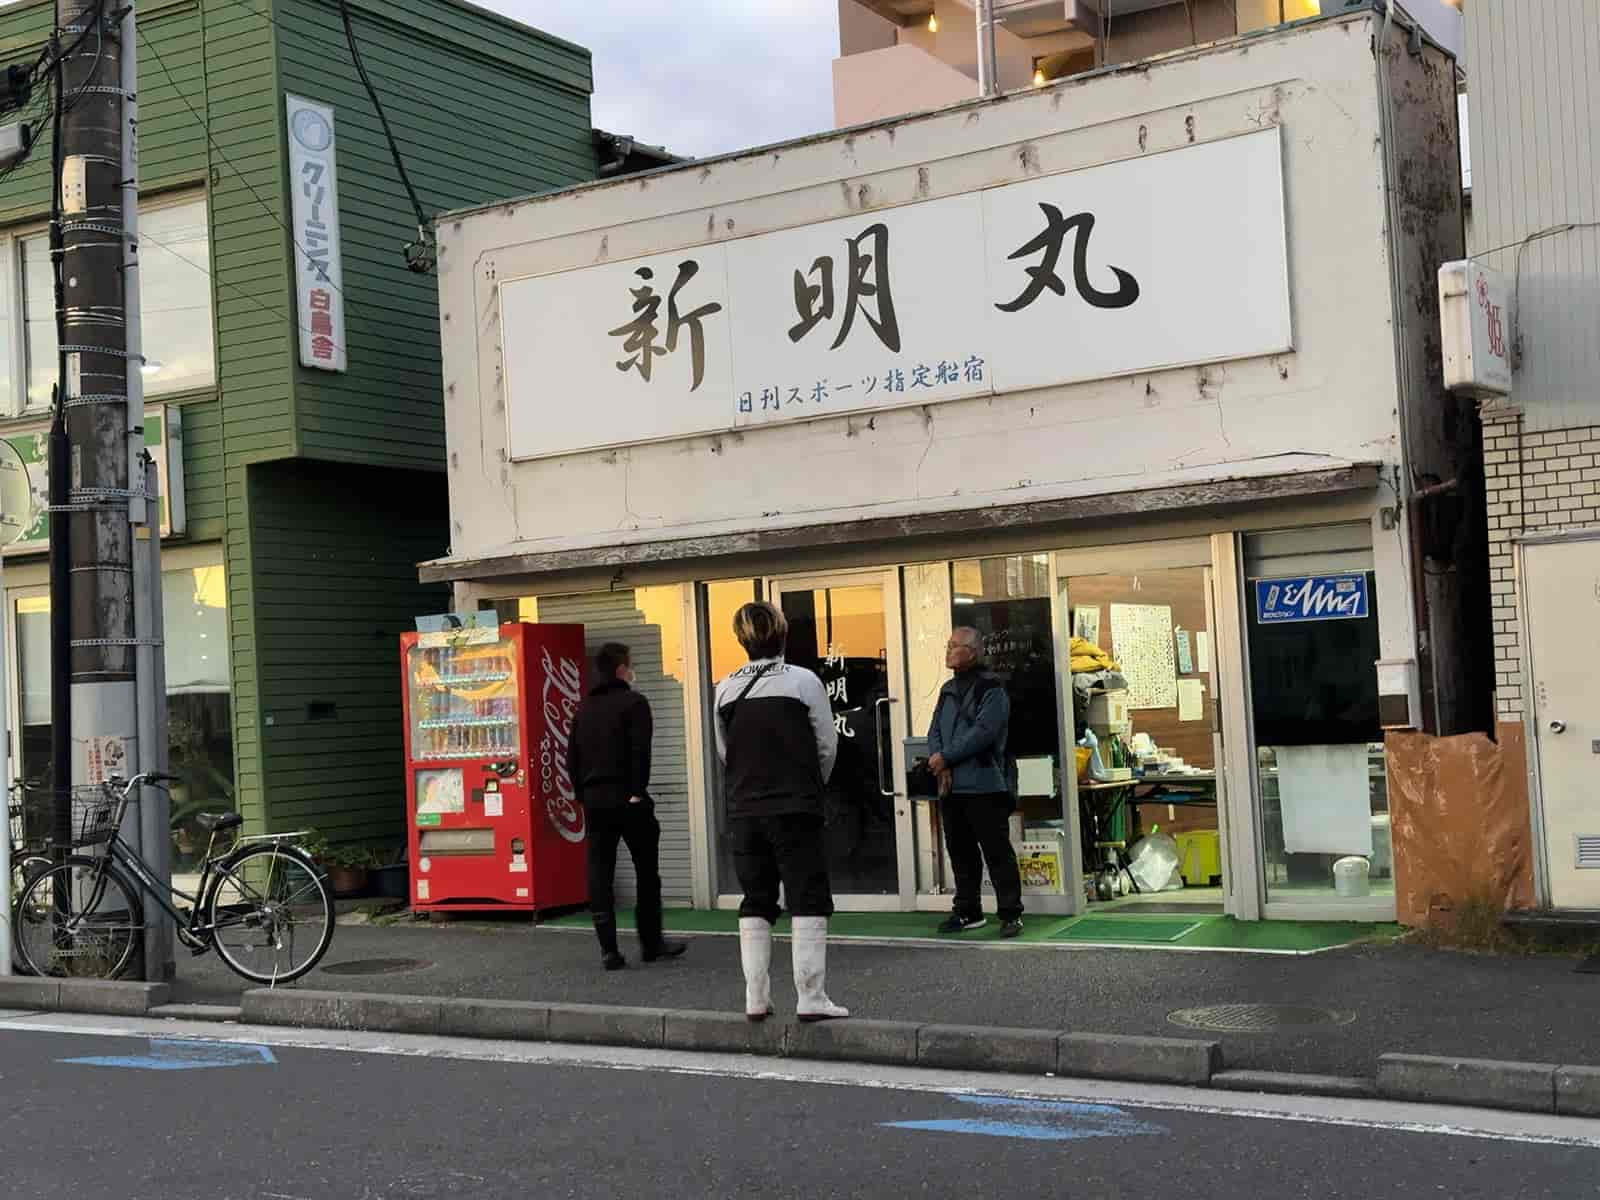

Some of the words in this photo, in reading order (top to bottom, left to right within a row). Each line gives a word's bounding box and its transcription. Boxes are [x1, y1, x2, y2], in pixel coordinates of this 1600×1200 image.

[301, 161, 330, 283] クリーニング
[607, 202, 1140, 393] 新明丸
[738, 355, 985, 413] 日刊スポーツ指定船宿
